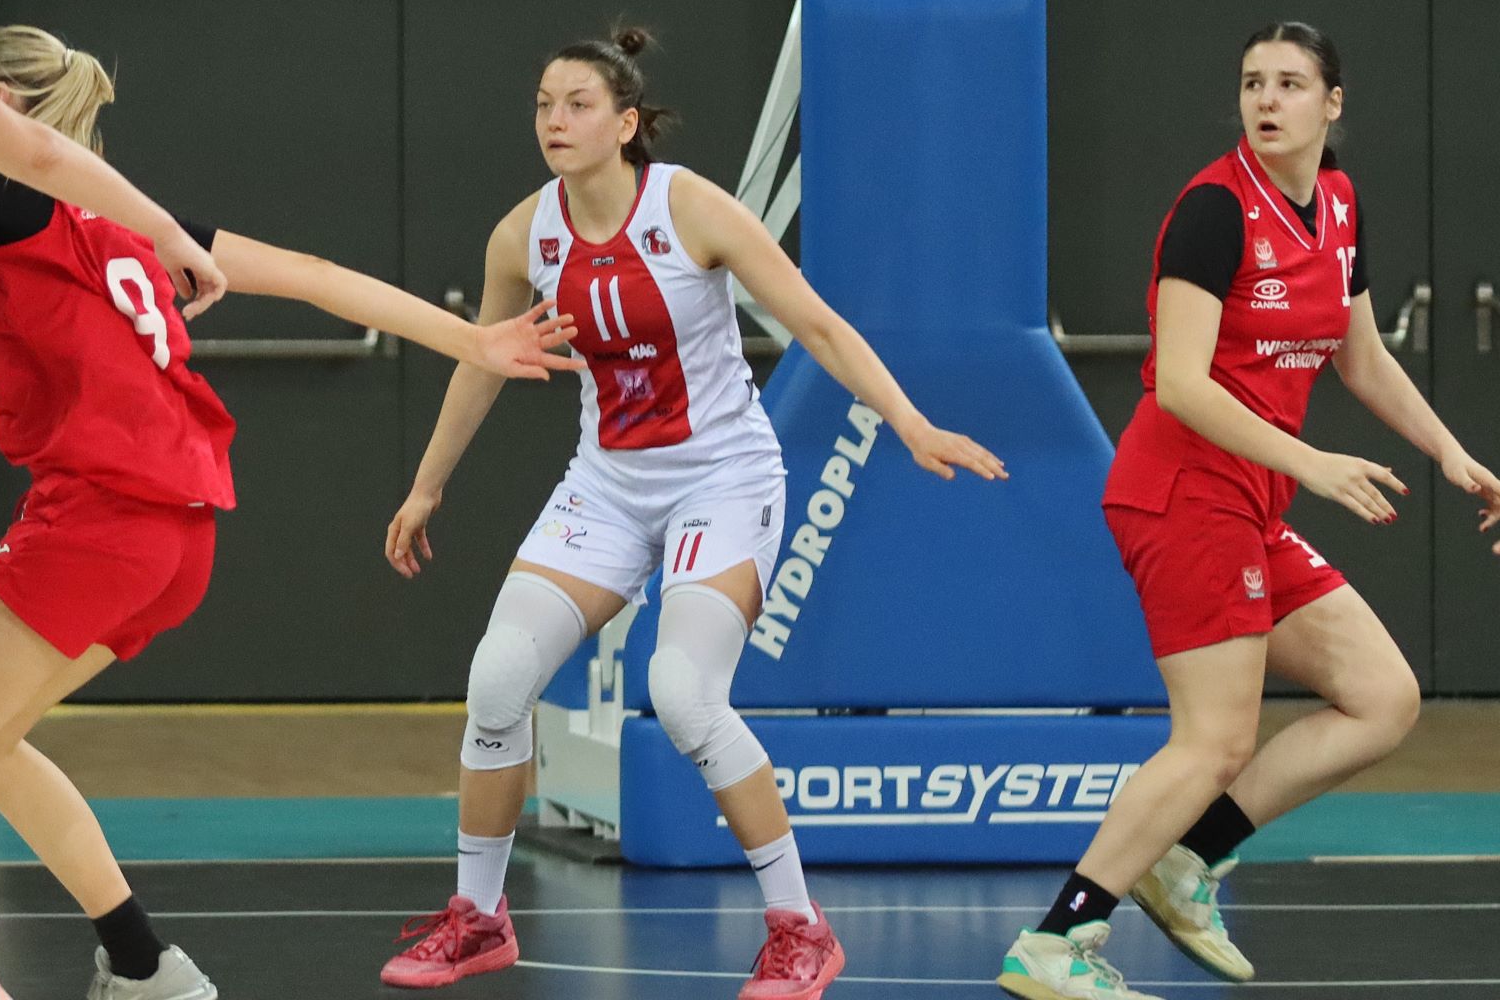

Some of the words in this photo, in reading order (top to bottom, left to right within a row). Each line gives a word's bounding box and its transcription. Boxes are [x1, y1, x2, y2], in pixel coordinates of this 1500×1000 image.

[106, 257, 171, 371] 9
[589, 275, 631, 342] 11
[1250, 301, 1290, 310] CANPACK
[672, 530, 703, 574] 11
